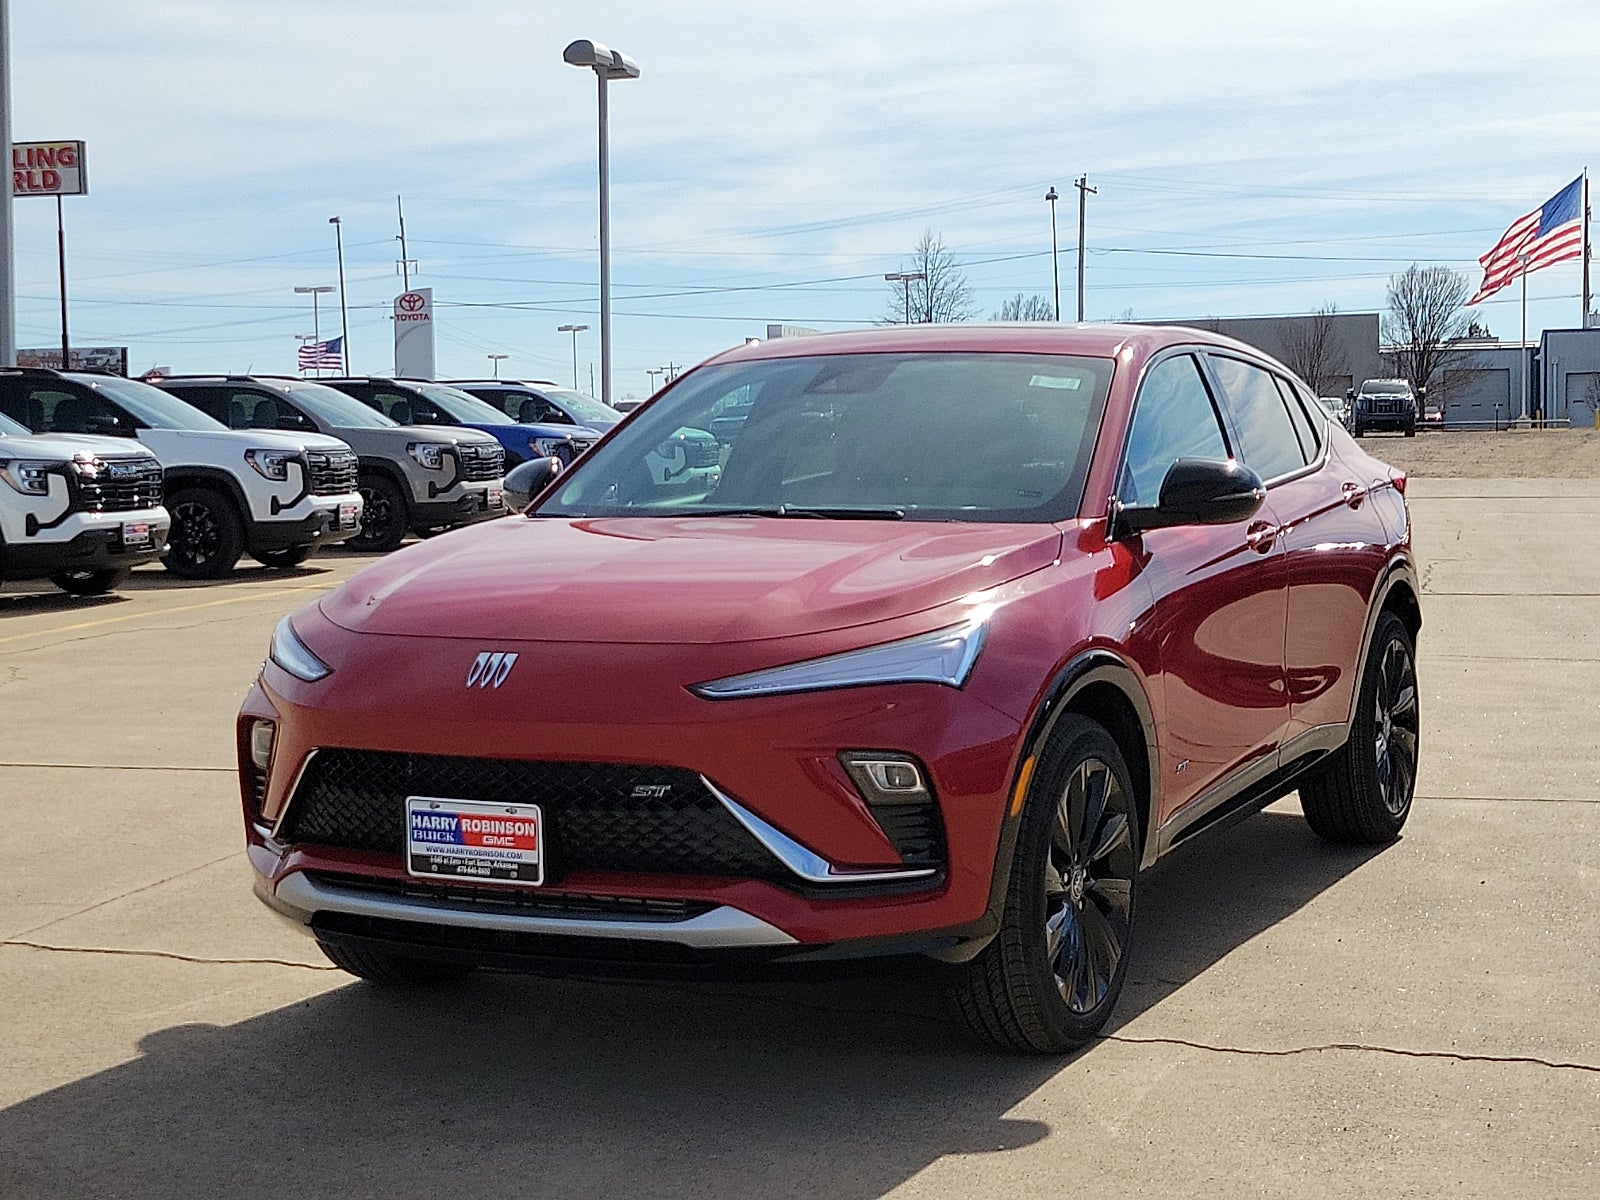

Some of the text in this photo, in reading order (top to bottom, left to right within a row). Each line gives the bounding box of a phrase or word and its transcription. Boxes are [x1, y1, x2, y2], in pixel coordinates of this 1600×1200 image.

[396, 313, 430, 321] TOYOTA
[631, 784, 672, 798] ST
[412, 814, 535, 837] HARRY ROBINSON
[412, 829, 516, 847] BUICK GMC
[426, 845, 523, 860] WWW.HARRYROBINSON.COM
